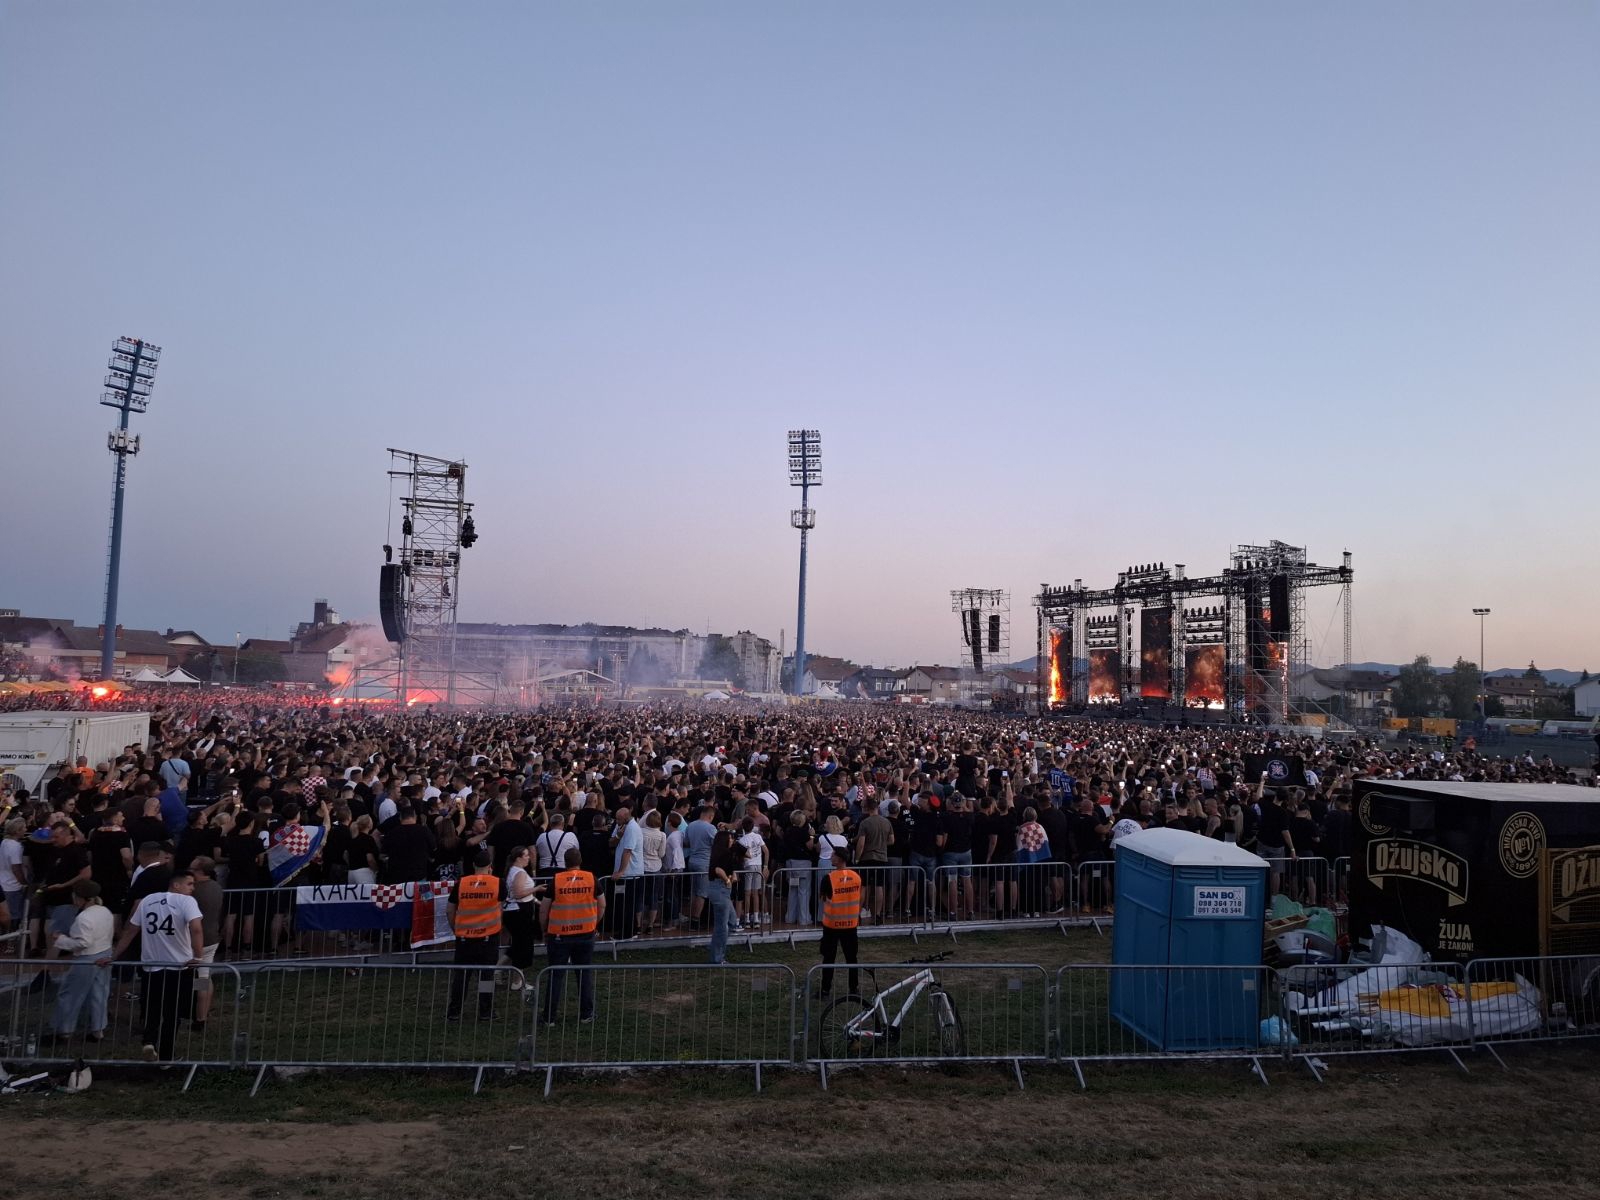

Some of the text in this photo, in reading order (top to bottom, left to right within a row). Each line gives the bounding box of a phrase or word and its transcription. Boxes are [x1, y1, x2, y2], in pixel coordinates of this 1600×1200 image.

[559, 887, 592, 895] SECURITY
[834, 886, 860, 895] SECURITY
[1199, 891, 1219, 899] SAN
[460, 892, 495, 900] SECURITY
[146, 911, 175, 936] 34
[1439, 918, 1472, 941] ŽUJA
[1437, 940, 1474, 952] JE ZAKON!
